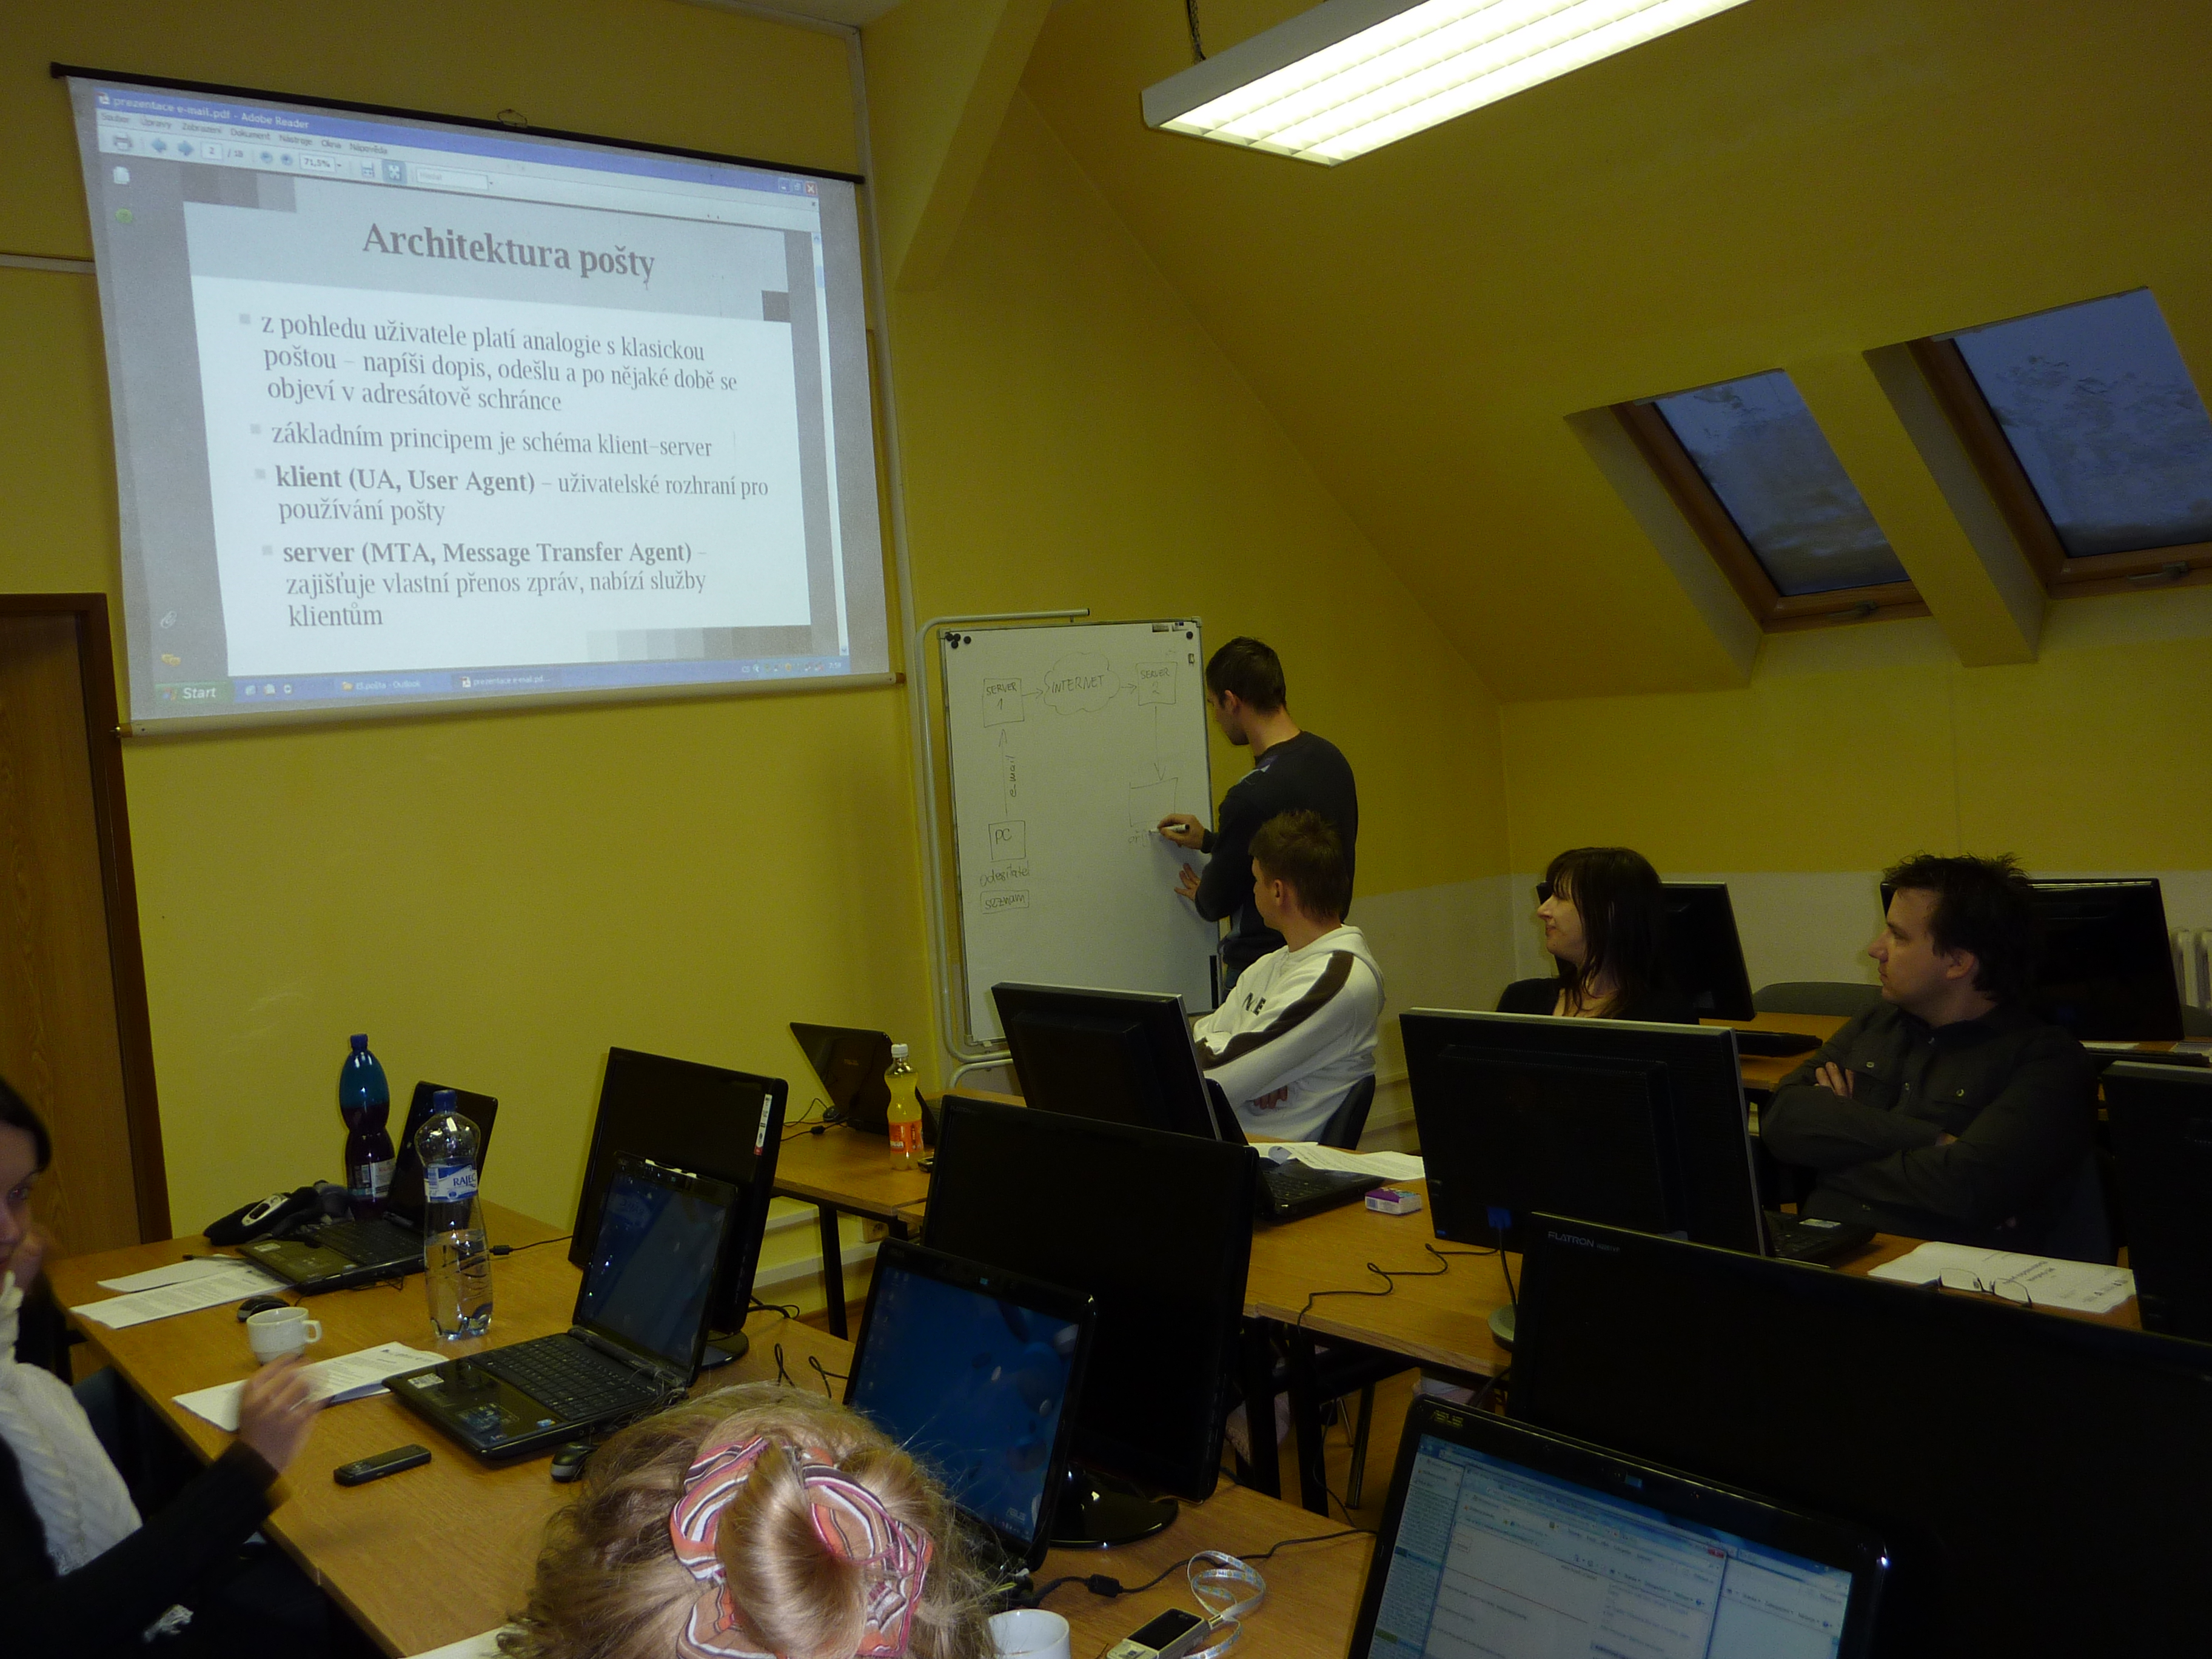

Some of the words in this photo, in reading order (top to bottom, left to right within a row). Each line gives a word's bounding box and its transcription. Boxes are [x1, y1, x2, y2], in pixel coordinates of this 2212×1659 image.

[113, 98, 174, 112] prezentace
[177, 106, 230, 119] e-mail.pdf
[241, 112, 272, 124] Adobe
[275, 116, 310, 129] Reader
[230, 128, 271, 140] Dokument
[321, 139, 341, 149] Okna
[304, 156, 331, 168] 71,5%
[362, 223, 571, 270] Architektura
[578, 244, 655, 290] pošty
[261, 316, 274, 333] z
[280, 314, 366, 339] pohledu
[374, 320, 467, 346] uživatele
[472, 326, 517, 351] platí
[523, 331, 601, 358] analogie
[607, 340, 615, 355] s
[621, 336, 705, 361] klasickou
[264, 345, 337, 370] poštou
[363, 352, 426, 377] napíši
[432, 354, 492, 381] dopis,
[498, 359, 560, 381] odešlu
[566, 367, 576, 382] a
[582, 367, 605, 387] po
[611, 366, 669, 390] nějaké
[674, 369, 716, 390] době
[720, 374, 737, 391] se
[267, 377, 336, 404] objeví
[341, 386, 354, 402] v
[362, 383, 471, 407] adresátově
[478, 388, 562, 411] schránce
[272, 421, 384, 447] základním
[389, 428, 493, 454] principem
[498, 432, 515, 455] je
[523, 431, 591, 453] schéma
[275, 464, 342, 488] klient
[349, 468, 401, 493] (UA,
[407, 470, 458, 490] User
[465, 471, 535, 496] Agent)
[558, 472, 660, 494] uživatelské
[665, 475, 736, 495] rozhraní
[741, 481, 769, 499] pro
[278, 498, 384, 525] používání
[390, 500, 446, 526] pošty
[283, 546, 355, 563] server
[361, 543, 437, 566] (MTA,
[443, 543, 531, 567] Message
[536, 541, 623, 561] Transfer
[629, 542, 692, 566] Agent)
[286, 572, 375, 599] zajišťuje
[382, 572, 449, 594] vlastní
[456, 572, 520, 597] přenos
[527, 571, 585, 595] zpráv,
[589, 571, 645, 591] nabízí
[650, 570, 706, 594] služby
[289, 602, 384, 626] klientům
[474, 676, 511, 686] prezentace
[1051, 675, 1104, 694] INTERNET
[1140, 667, 1170, 680] SERVER
[182, 686, 216, 700] Start
[987, 682, 1017, 696] SERVER
[997, 698, 1003, 710] 1
[1005, 755, 1017, 798] e-mail
[995, 822, 1012, 845] PC
[985, 894, 1025, 910] seznam
[453, 1173, 476, 1187] RAJEC
[1547, 1230, 1595, 1248] FLATRON
[1430, 1409, 1464, 1429] ASUS
